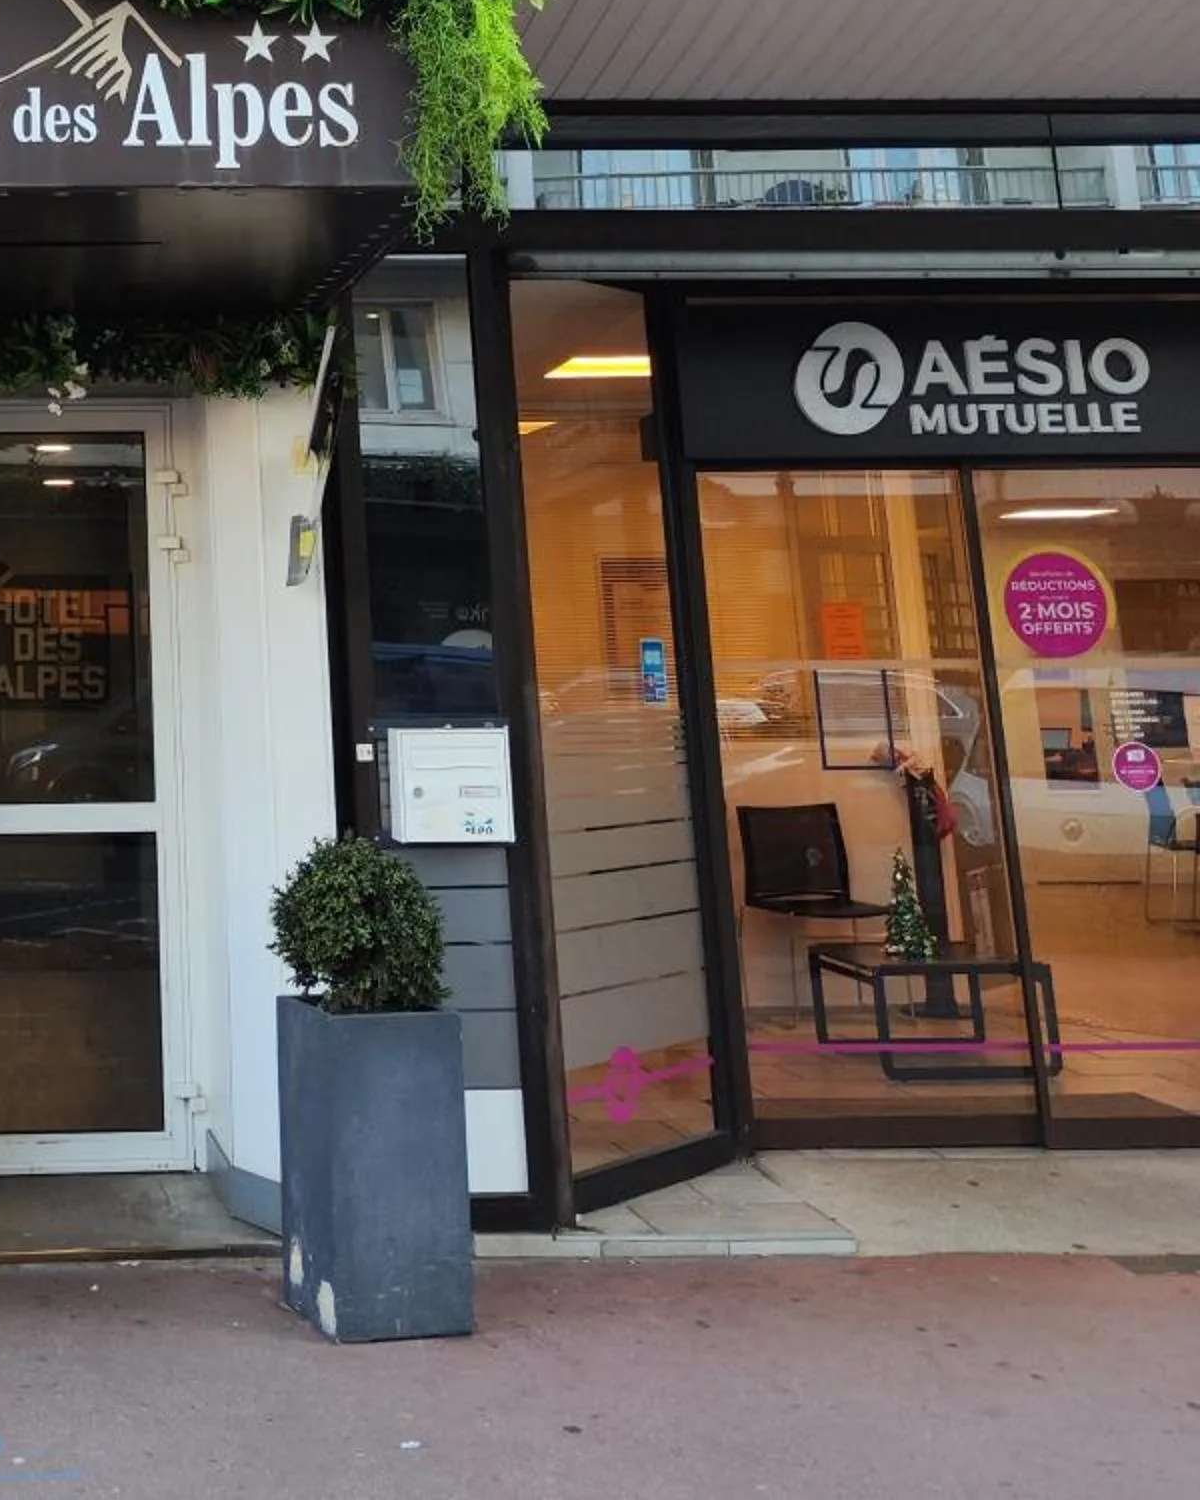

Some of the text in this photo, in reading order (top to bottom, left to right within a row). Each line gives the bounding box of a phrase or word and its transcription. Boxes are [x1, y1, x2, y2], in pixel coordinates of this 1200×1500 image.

[11, 87, 98, 144] des
[122, 52, 360, 170] Alpes
[909, 334, 1150, 397] AÉSIO
[909, 401, 1142, 435] MUTUELLE
[1017, 601, 1096, 620] 2 MOIS
[13, 627, 83, 662] DES
